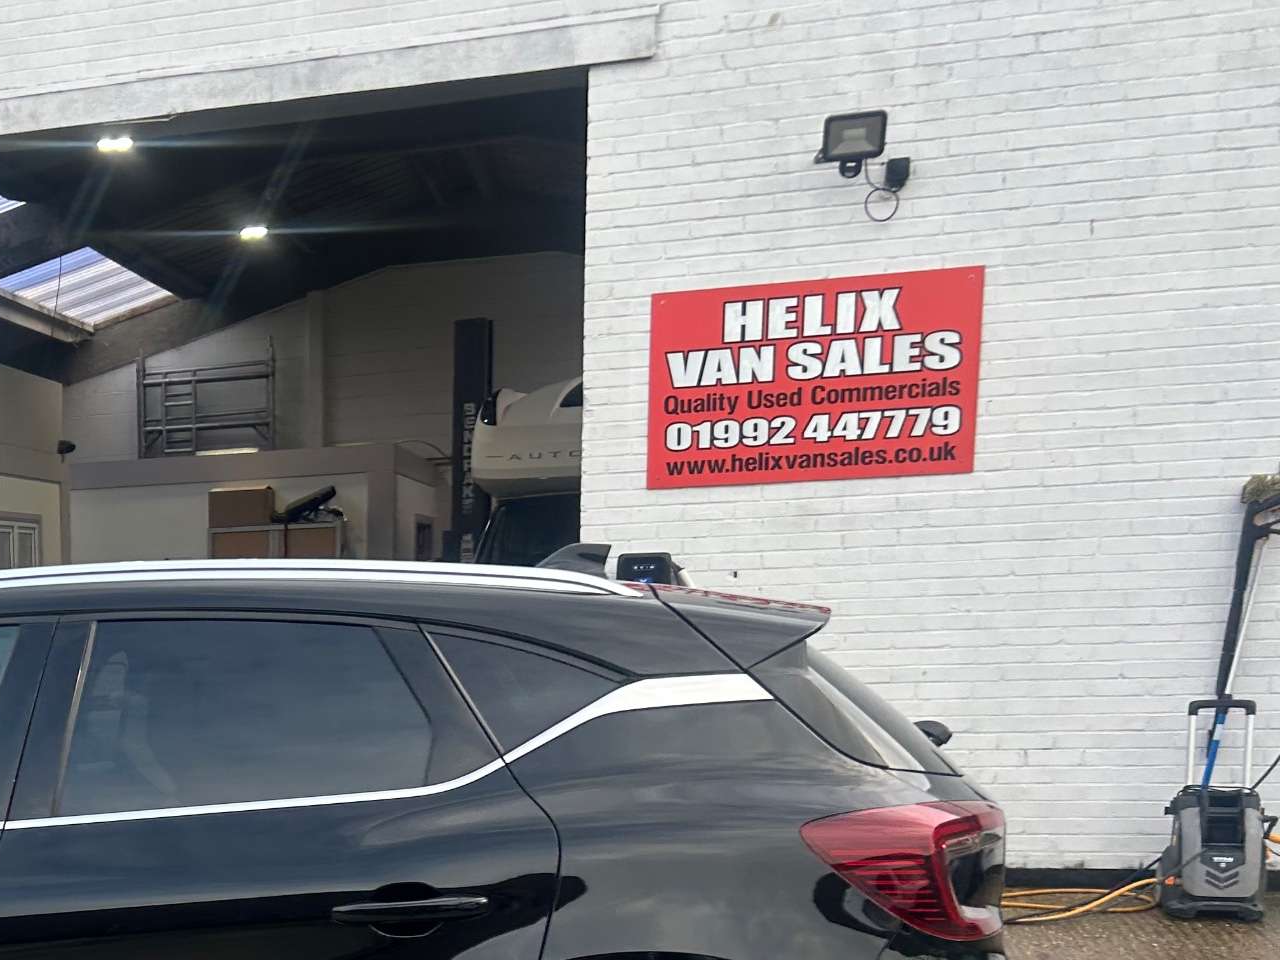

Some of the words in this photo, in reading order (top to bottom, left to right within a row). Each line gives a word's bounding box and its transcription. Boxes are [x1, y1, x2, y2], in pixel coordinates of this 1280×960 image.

[722, 286, 903, 344] HELIX
[665, 344, 776, 389] VAN
[786, 329, 963, 382] SALES
[664, 390, 739, 416] Quality
[746, 386, 803, 410] Used
[810, 376, 961, 406] Commercials
[664, 415, 797, 452] 01992
[803, 404, 962, 443] 447779
[665, 441, 957, 476] www.helixvansales.co.uk
